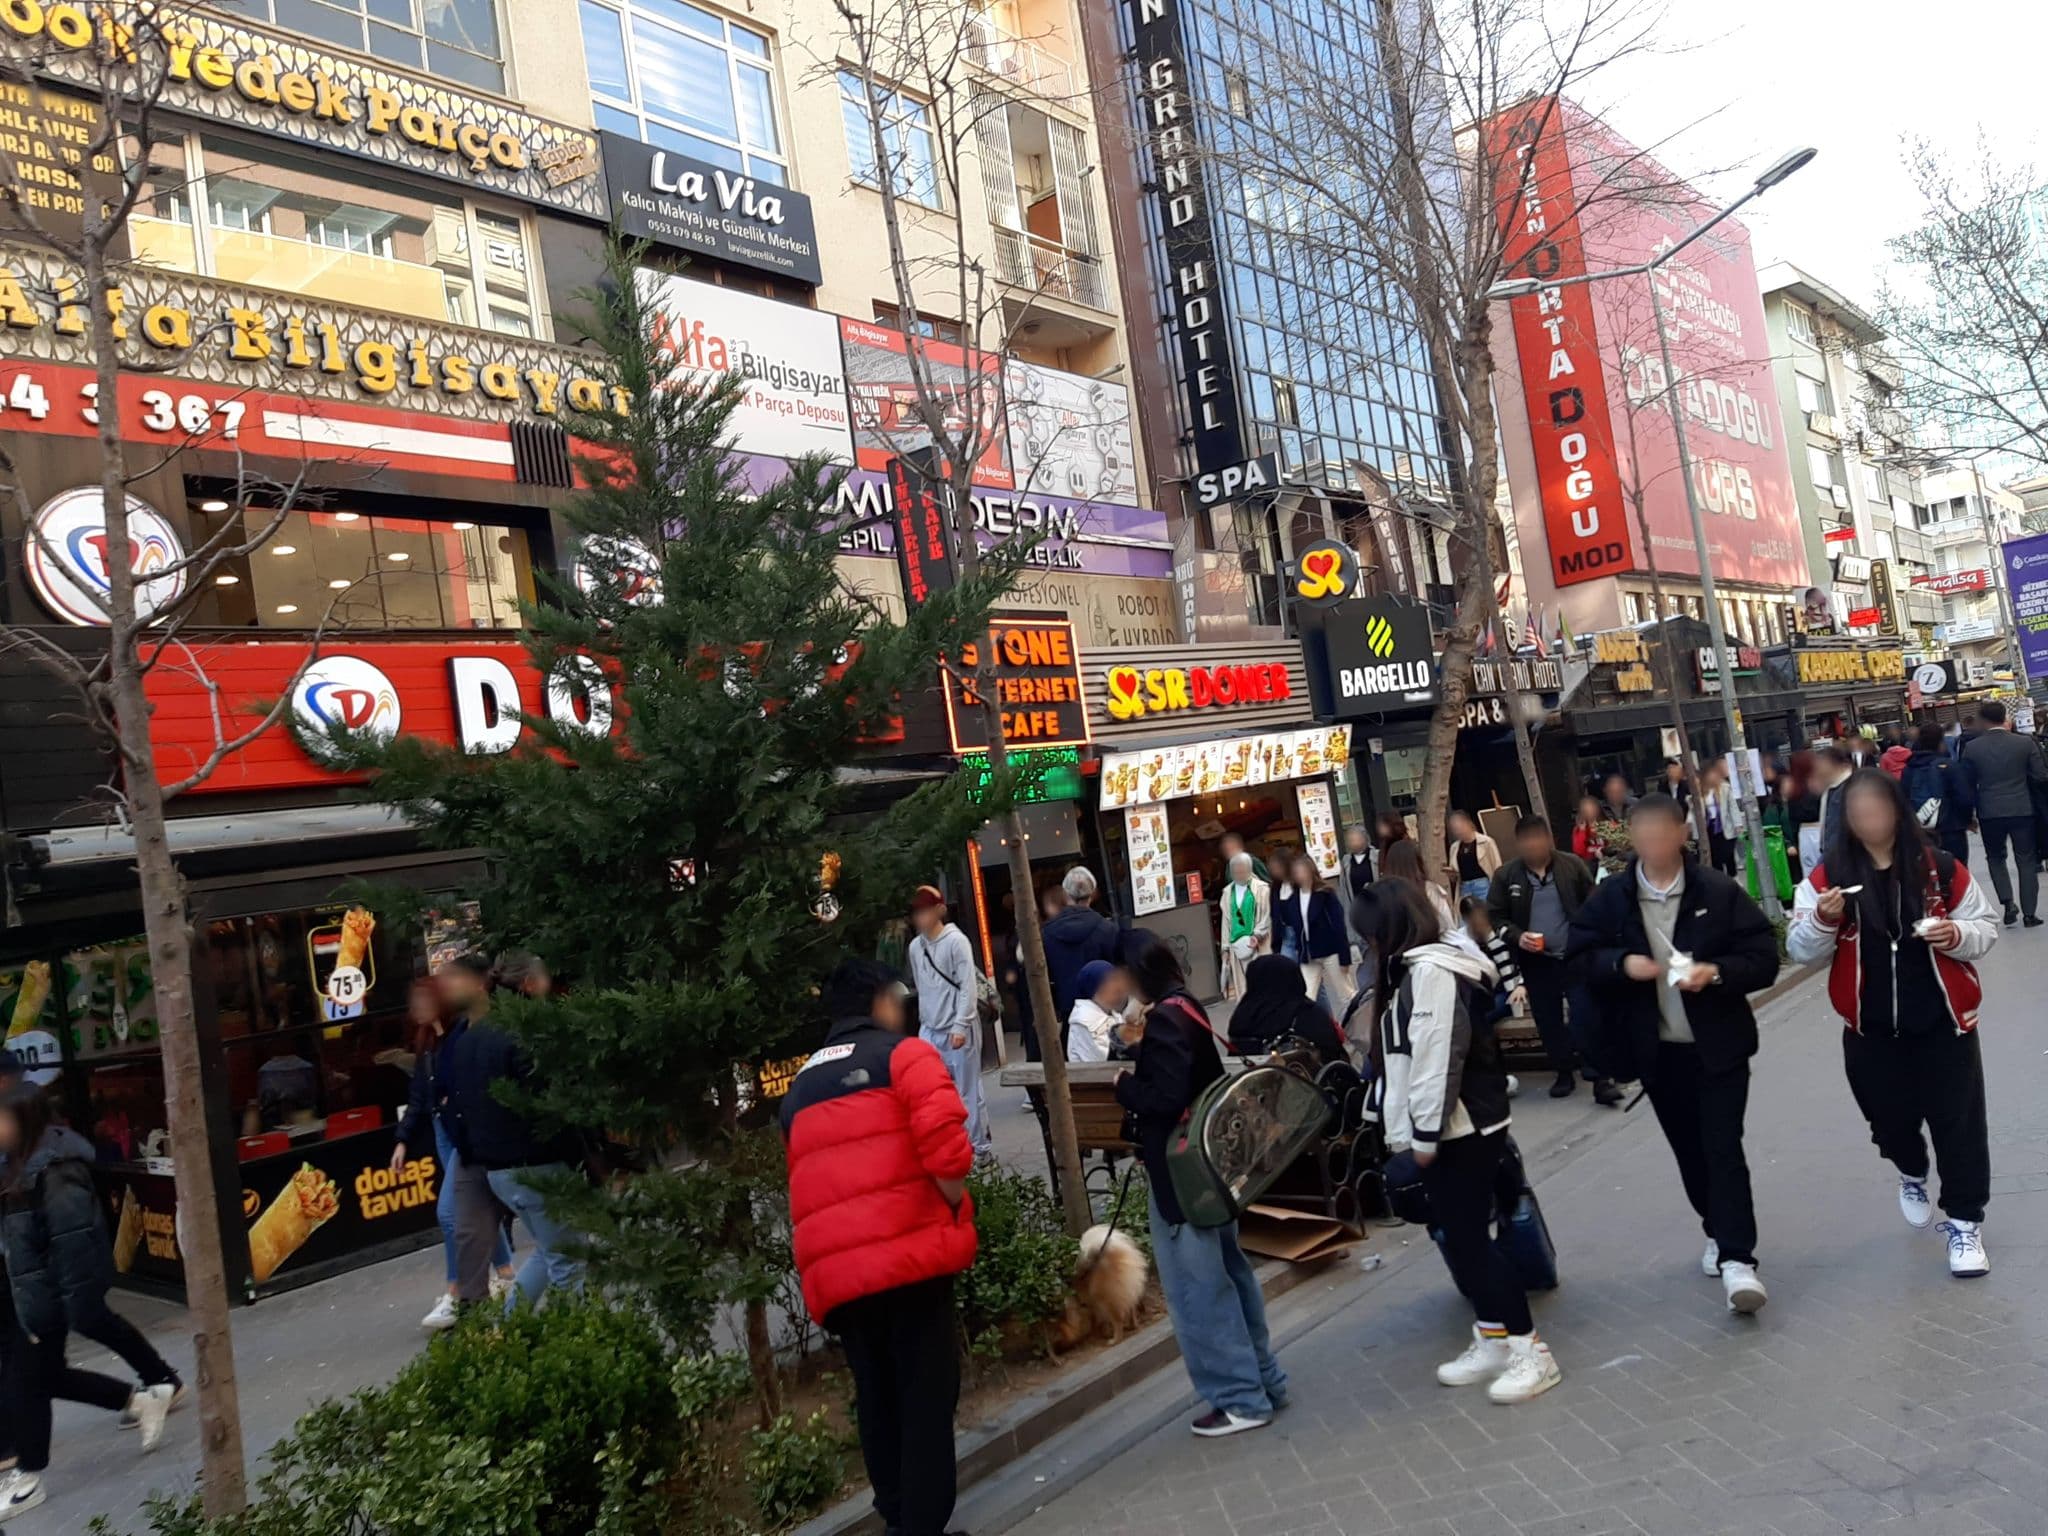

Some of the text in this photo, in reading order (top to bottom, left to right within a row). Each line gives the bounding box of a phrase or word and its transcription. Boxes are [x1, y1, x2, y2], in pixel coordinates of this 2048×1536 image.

[364, 86, 527, 172] Parça
[651, 151, 785, 225] La Via
[622, 190, 811, 256] Kalıcı Makyaj ve Güzellik Merkezi
[1149, 57, 1194, 228] GRAND
[1179, 261, 1225, 431] HOTEL
[651, 310, 731, 374] Alfa
[740, 352, 842, 398] Bilgisayar
[142, 390, 247, 440] 367
[755, 392, 793, 417] Parça
[797, 399, 846, 424] Deposu
[1197, 460, 1267, 504] SPA
[1560, 542, 1625, 575] MOD
[1117, 595, 1160, 616] ROBOT
[1144, 668, 1190, 711] SR
[1339, 659, 1431, 698] BARGELLO
[332, 975, 353, 997] 75
[360, 1177, 438, 1220] tavuk
